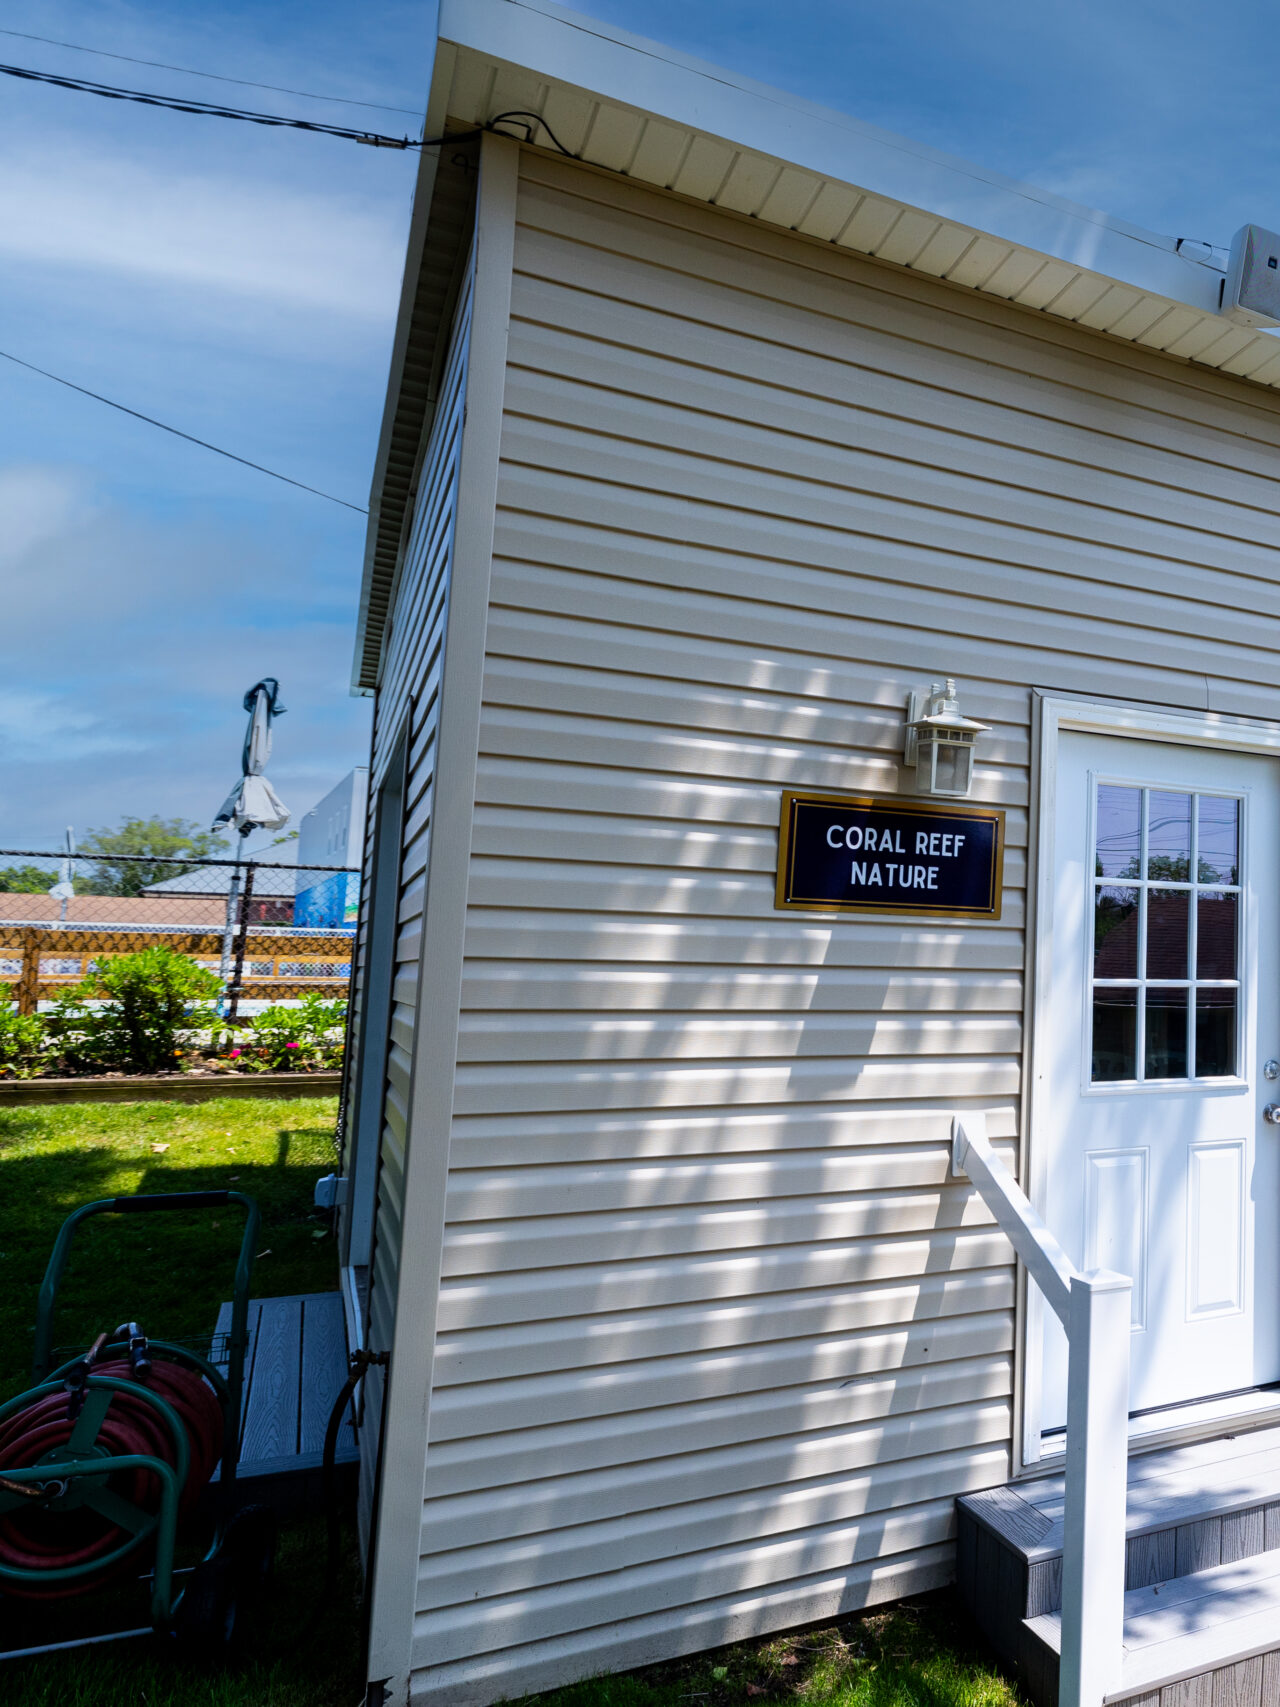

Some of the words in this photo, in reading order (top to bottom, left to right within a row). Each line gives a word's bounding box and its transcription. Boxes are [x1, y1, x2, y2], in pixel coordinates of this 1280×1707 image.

[826, 824, 906, 854] CORAL
[915, 831, 966, 857] REEF
[851, 861, 940, 890] NATURE
